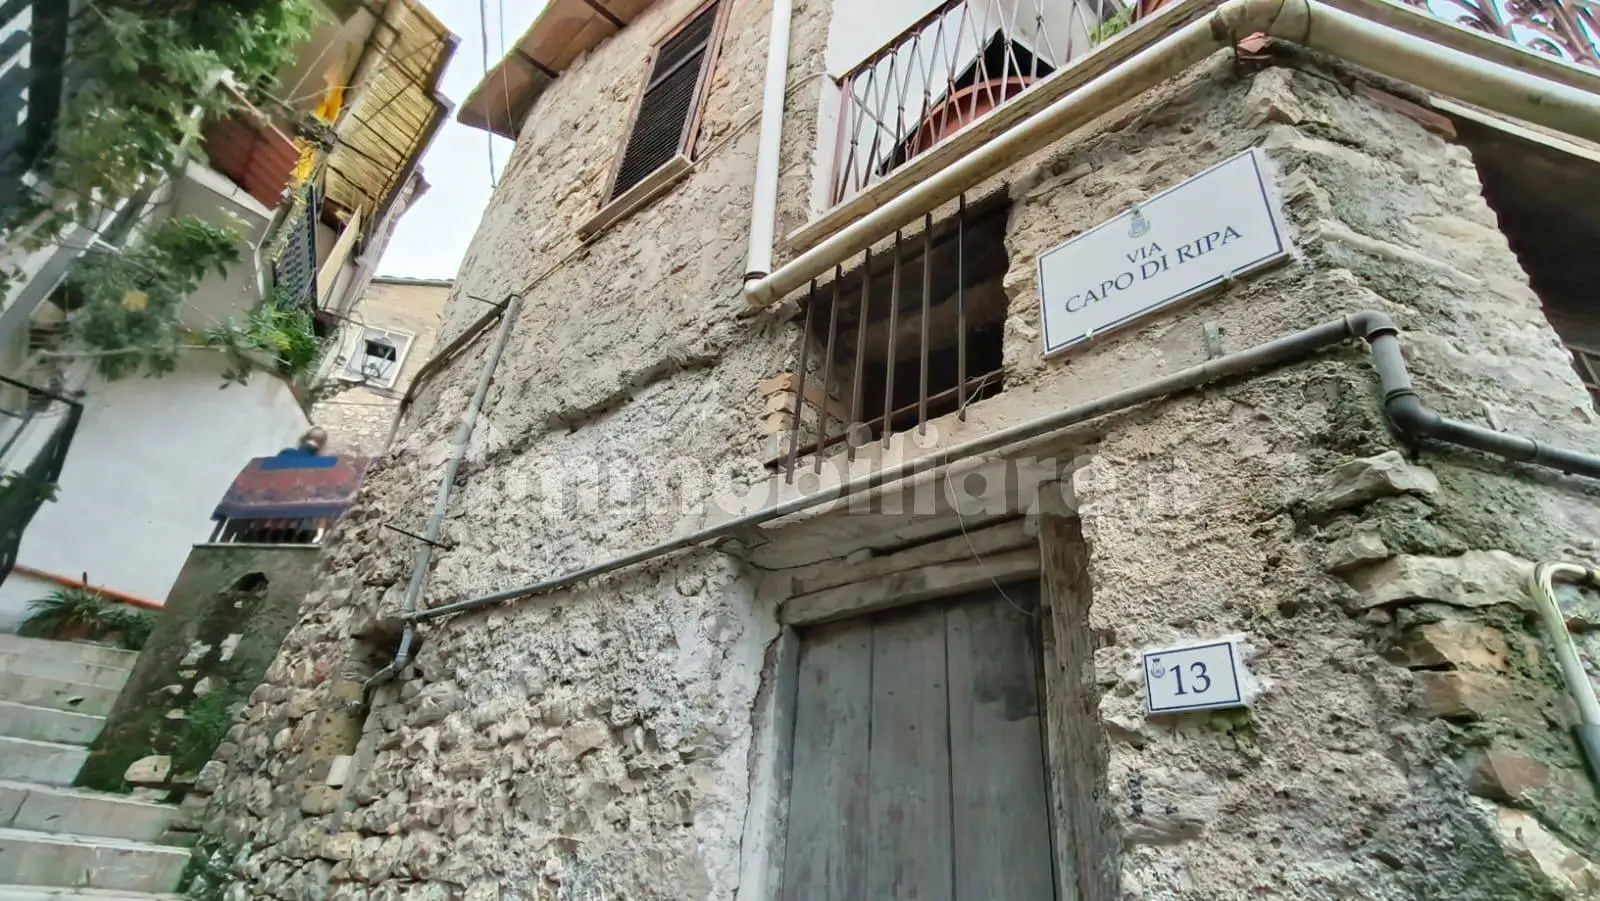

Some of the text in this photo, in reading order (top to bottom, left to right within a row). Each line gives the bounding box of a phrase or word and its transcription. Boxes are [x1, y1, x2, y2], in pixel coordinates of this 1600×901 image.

[1065, 226, 1242, 313] CAPO DI RIPA
[1126, 242, 1163, 264] VIA
[1169, 661, 1211, 696] 13
